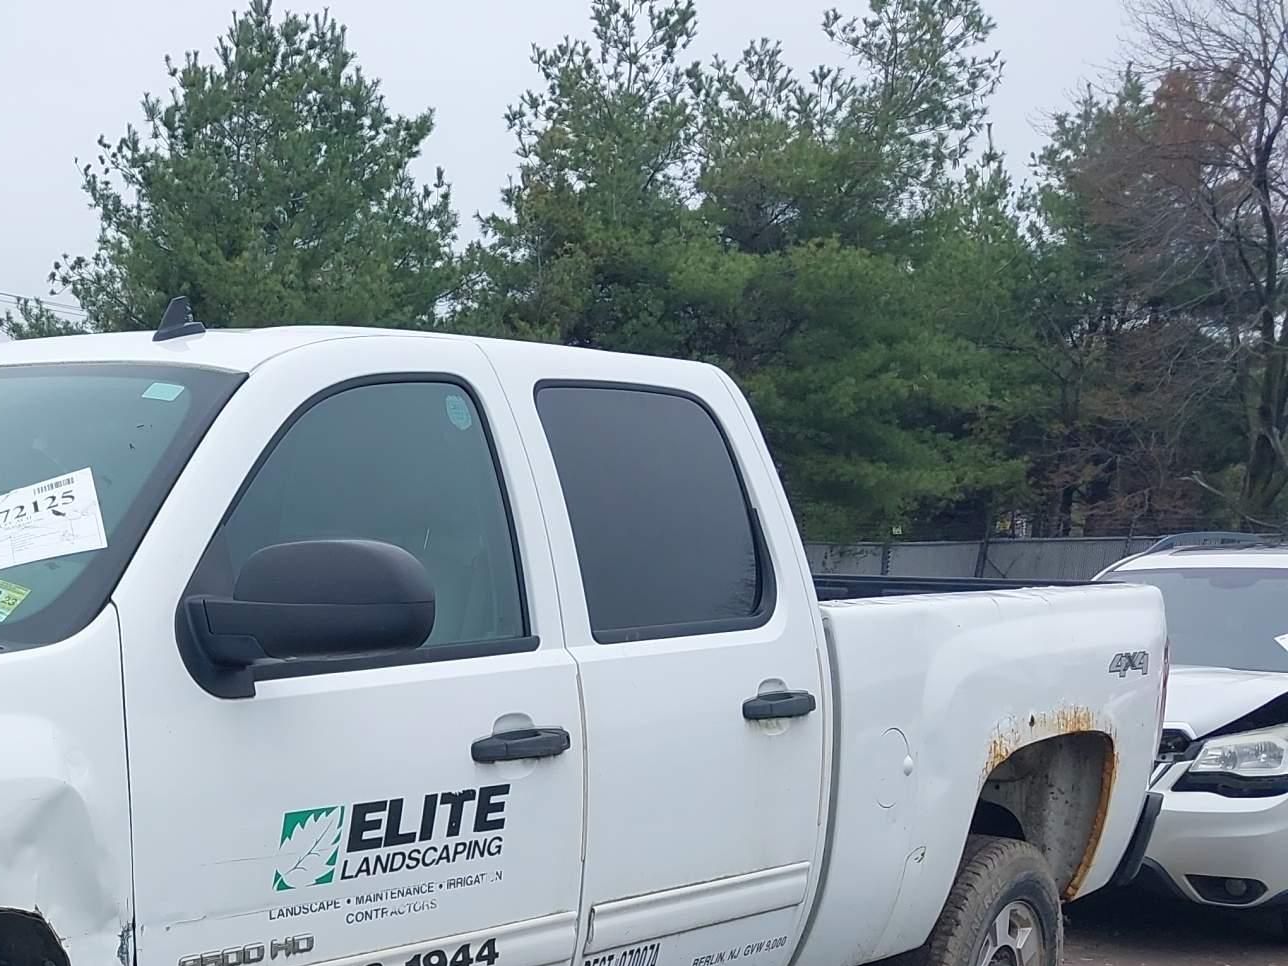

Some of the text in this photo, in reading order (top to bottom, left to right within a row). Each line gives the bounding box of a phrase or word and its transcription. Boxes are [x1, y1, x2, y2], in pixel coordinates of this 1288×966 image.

[345, 784, 511, 853] ELITE
[340, 836, 503, 880] LANDSCAPING
[269, 900, 341, 921] LANDSCAPE
[355, 881, 435, 906] MAINTENANCE
[270, 932, 314, 960] HD
[728, 947, 742, 961] NJ
[743, 941, 766, 957] GVW
